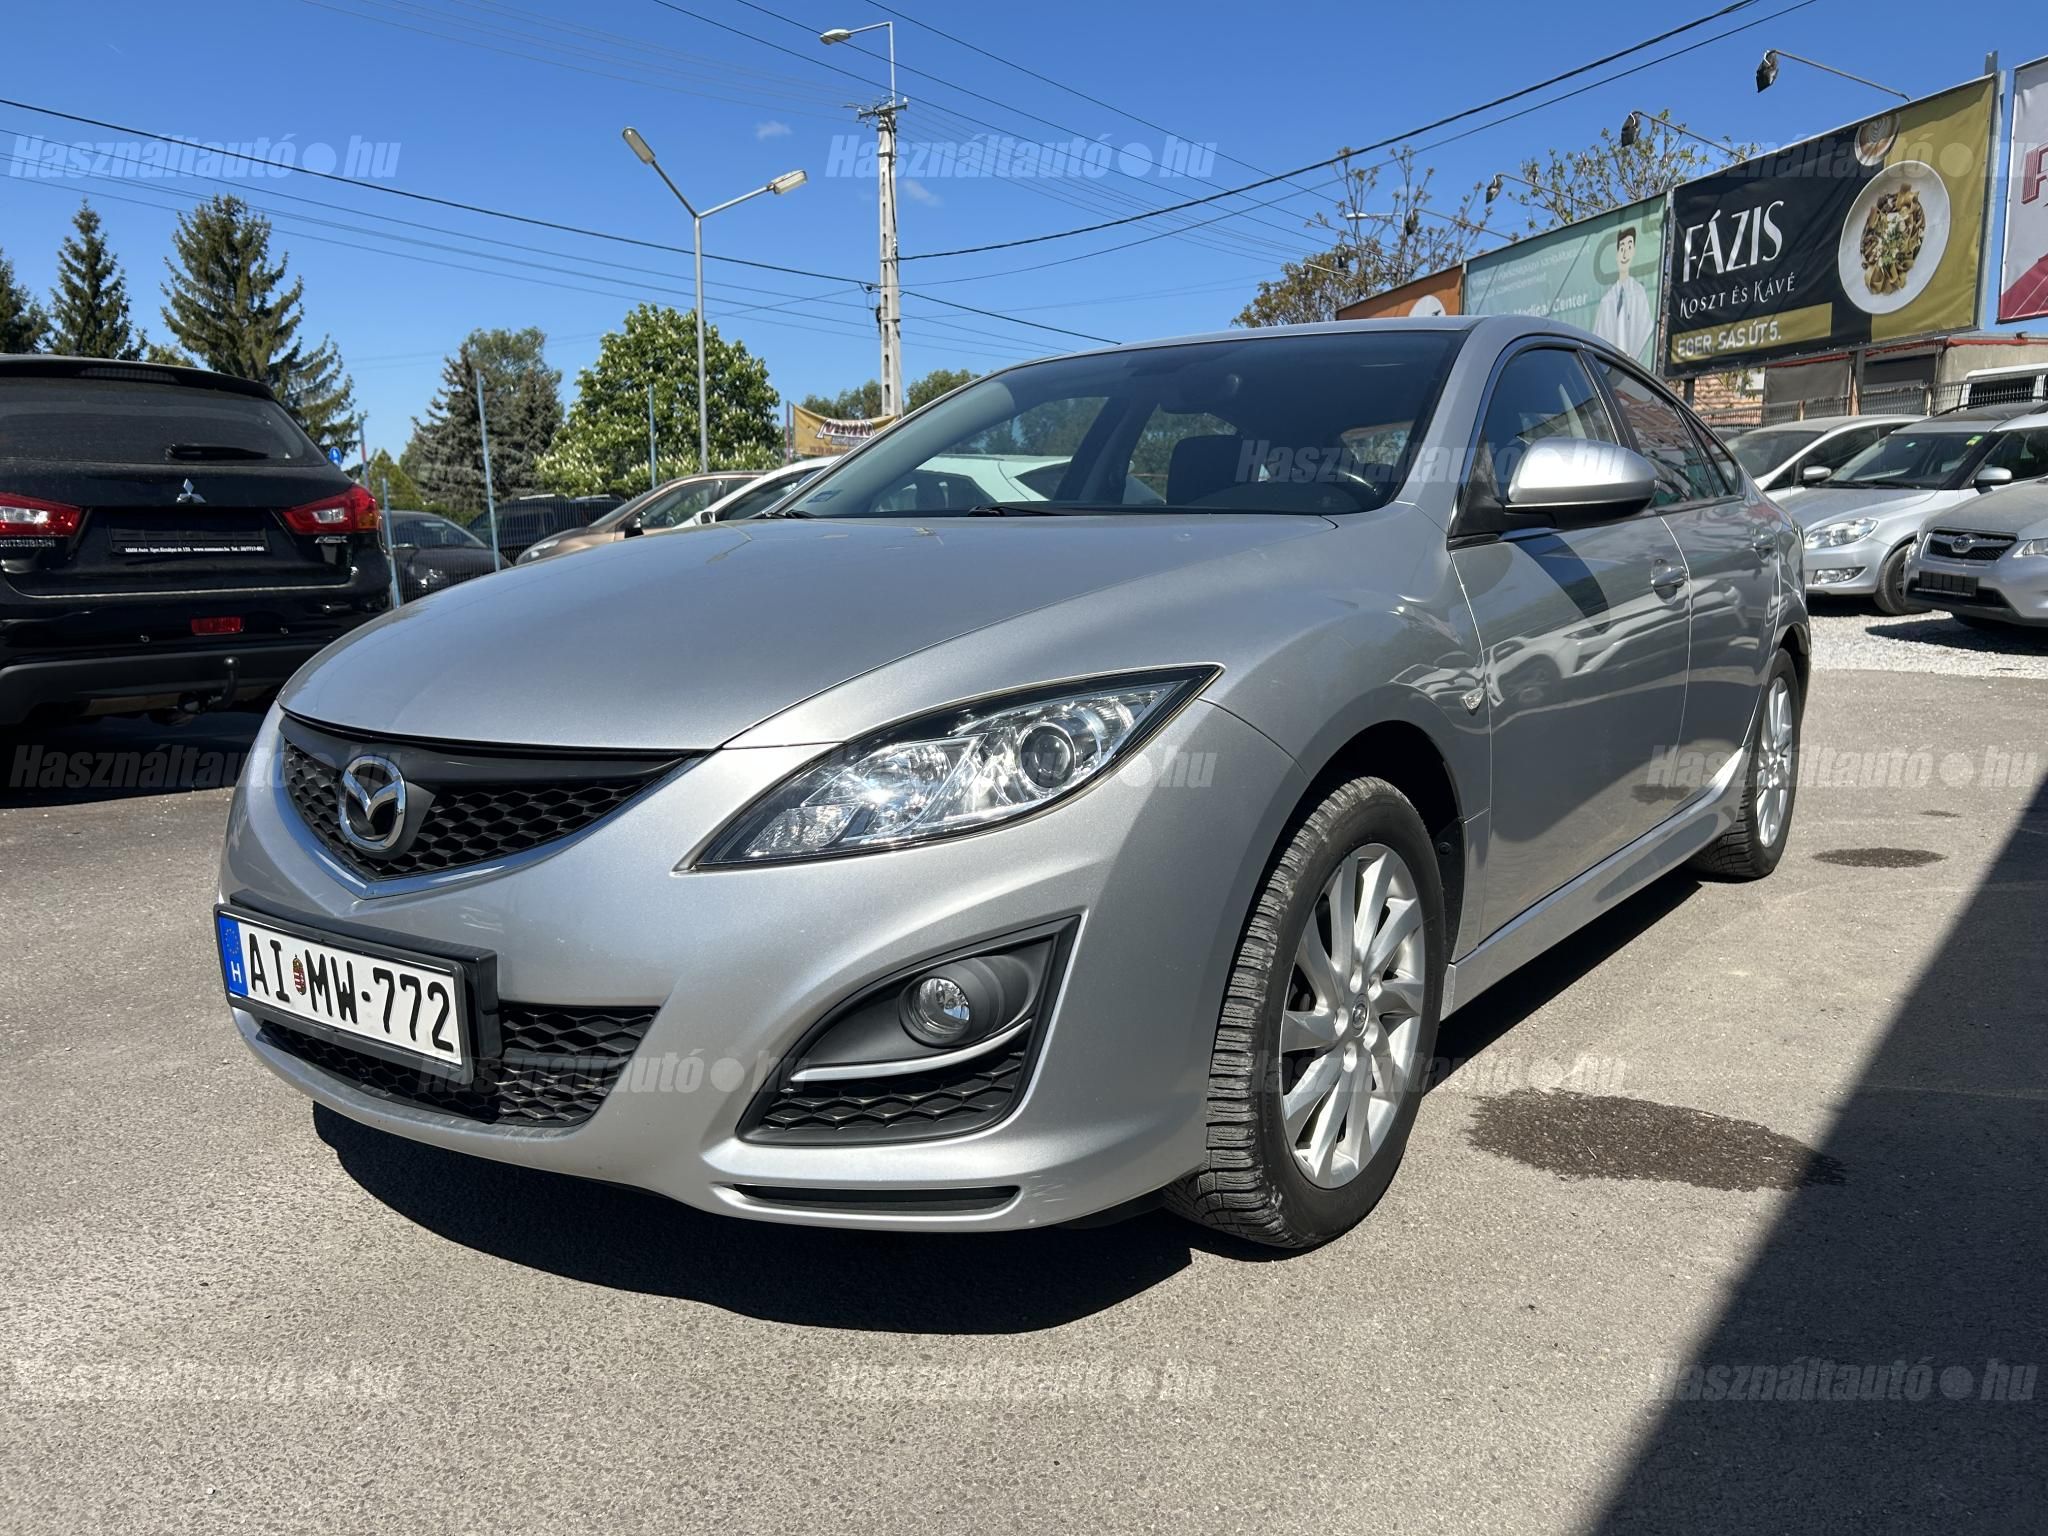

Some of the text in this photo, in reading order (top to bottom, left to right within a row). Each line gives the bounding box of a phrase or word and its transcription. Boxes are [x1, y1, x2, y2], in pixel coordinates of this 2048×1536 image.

[1683, 200, 1784, 282] FÁZIS
[1754, 272, 1795, 303] KÁVÉ
[1718, 327, 1746, 350] SAS
[230, 961, 242, 984] H
